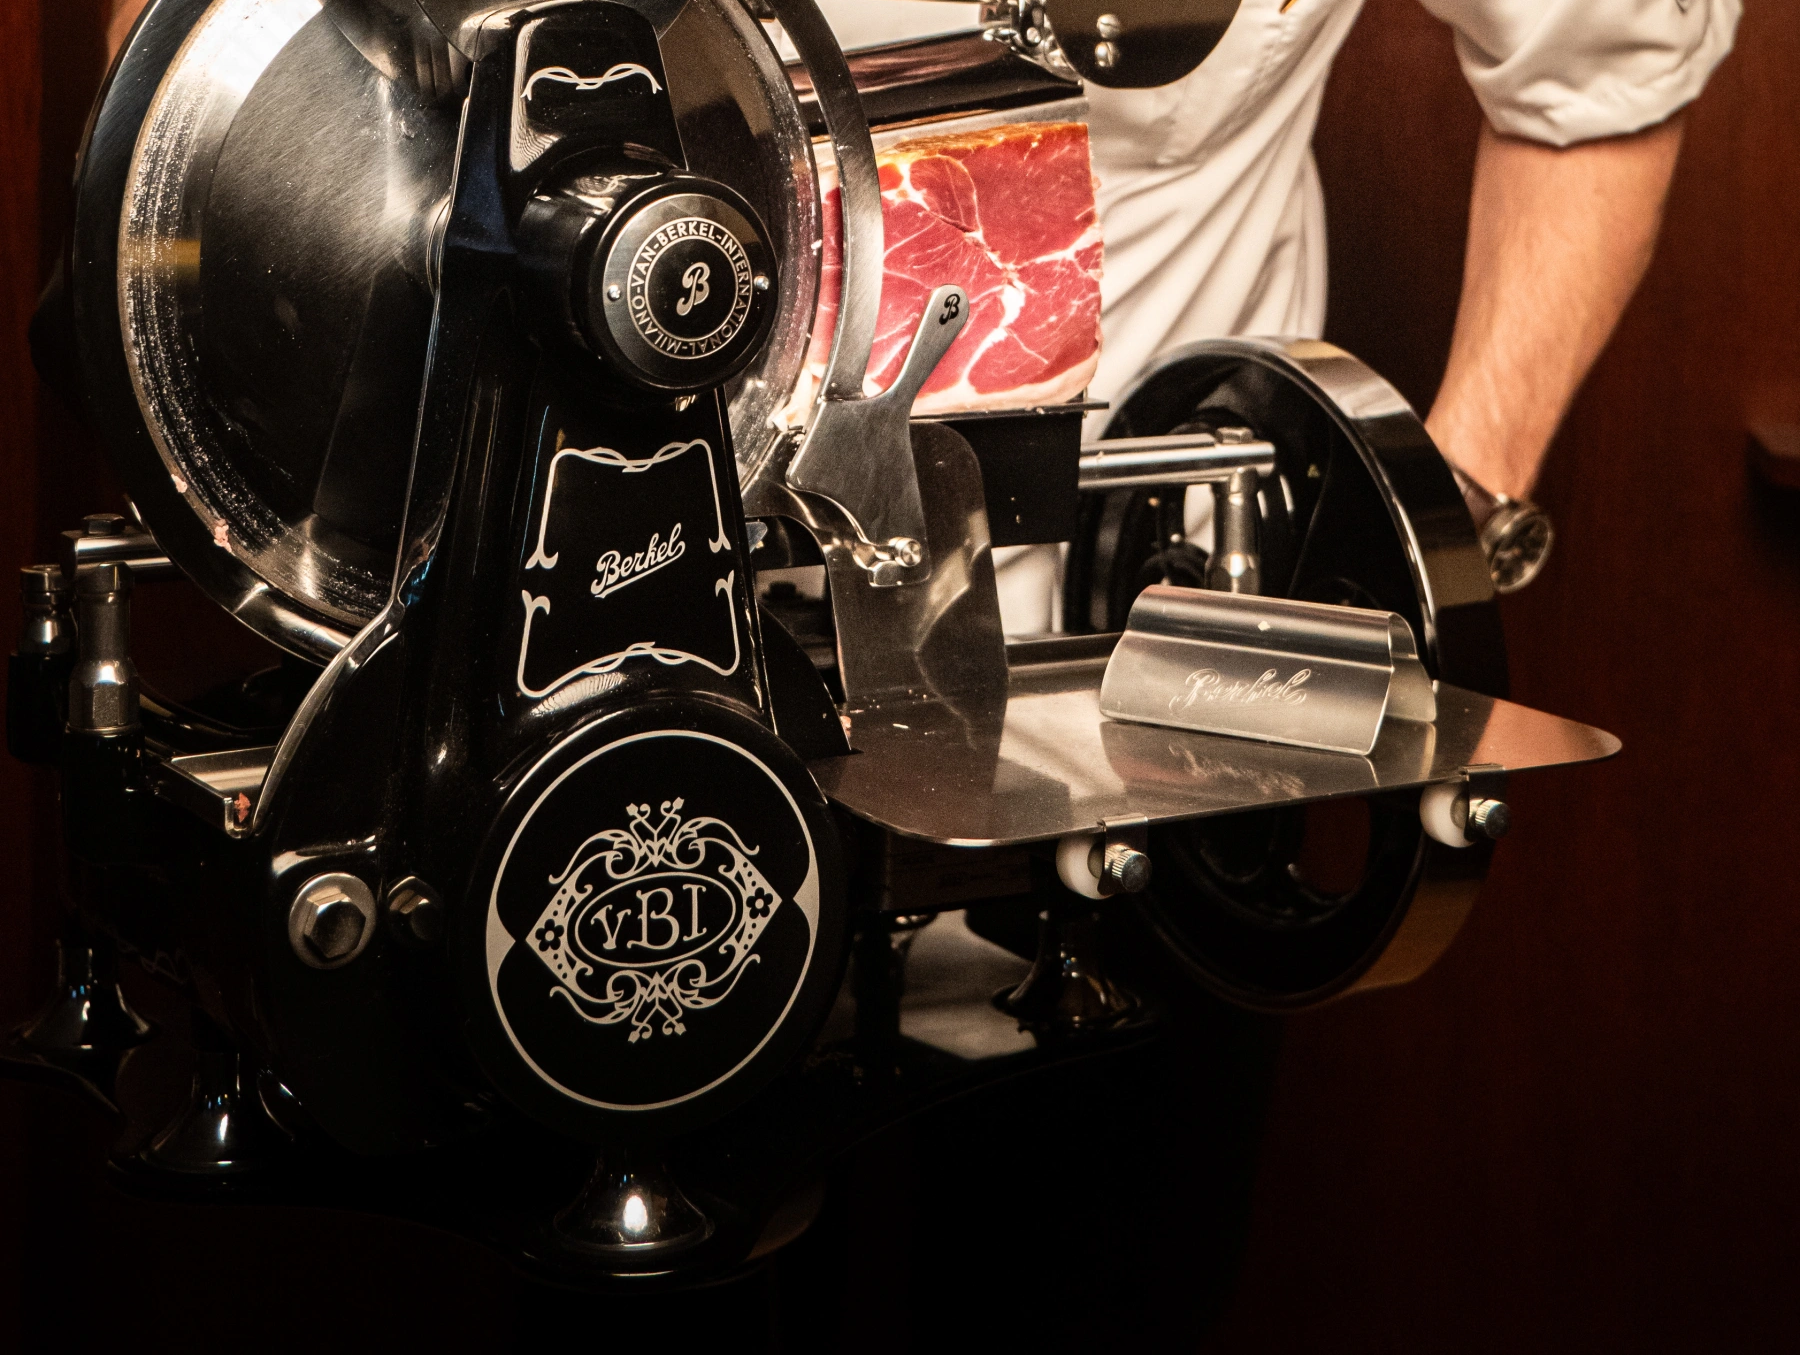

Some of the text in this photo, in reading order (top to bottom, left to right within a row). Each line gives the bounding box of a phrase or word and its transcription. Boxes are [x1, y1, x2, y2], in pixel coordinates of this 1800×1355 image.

[676, 262, 710, 316] B
[939, 293, 960, 325] B
[590, 522, 686, 599] Berkel
[590, 883, 707, 950] vBI
